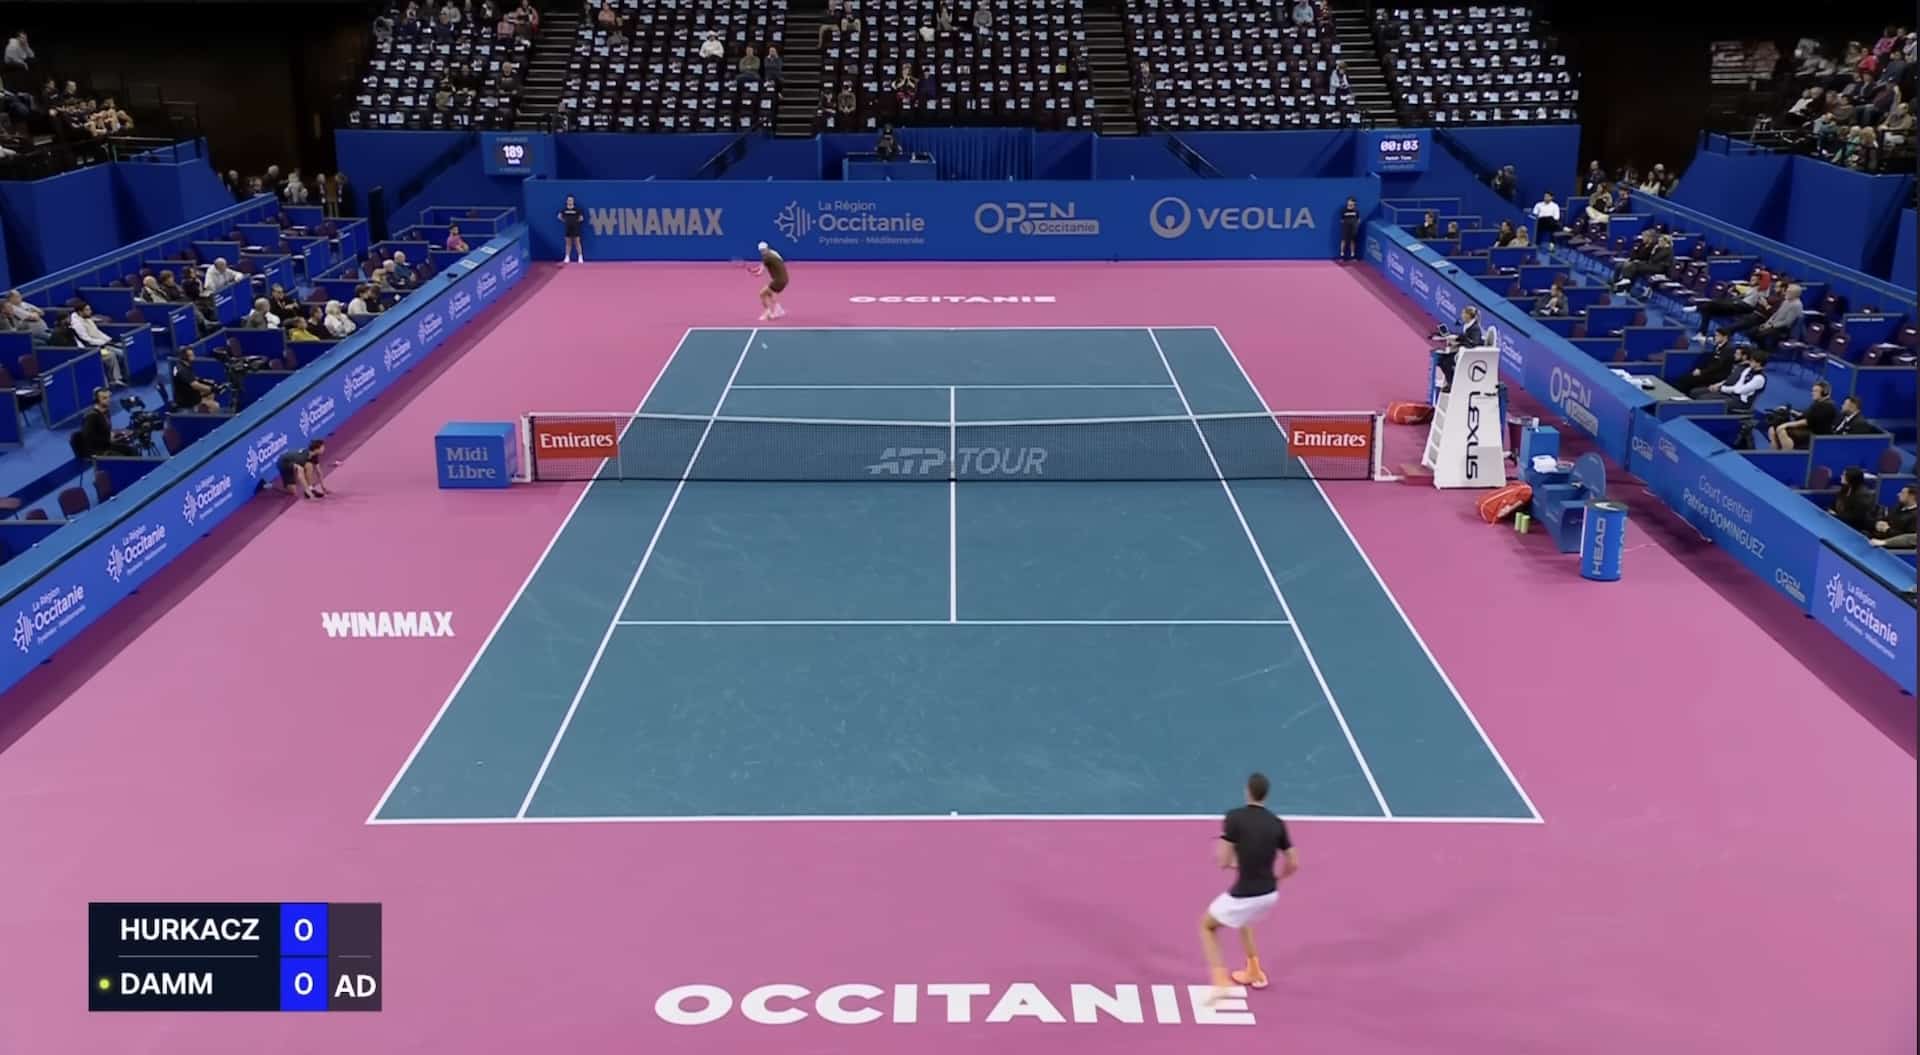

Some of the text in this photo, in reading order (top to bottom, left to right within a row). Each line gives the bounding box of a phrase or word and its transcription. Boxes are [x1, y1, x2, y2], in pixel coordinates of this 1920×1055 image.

[502, 145, 524, 158] 189
[817, 200, 876, 213] La Région
[974, 202, 1075, 234] OPEN
[1197, 207, 1317, 230] VEOLIA
[588, 208, 724, 236] WINAMAX
[818, 213, 925, 232] Occitanie
[1038, 222, 1097, 233] Occitanie
[849, 296, 1057, 304] OCCITANIE
[1550, 366, 1592, 409] OPEN
[540, 431, 614, 449] Emirates
[1293, 430, 1368, 447] Emirates
[1466, 391, 1481, 480] LEXUS
[447, 447, 489, 462] Midi
[864, 447, 1049, 475] ATP TOUR
[448, 464, 497, 480] Libre
[124, 523, 166, 564] Occitanie
[1592, 517, 1606, 576] HEAD
[34, 585, 84, 631] Occitanie
[1845, 595, 1898, 647] Occitanie
[320, 611, 456, 638] WINAMAX
[654, 983, 1257, 1026] OCCITANIE
